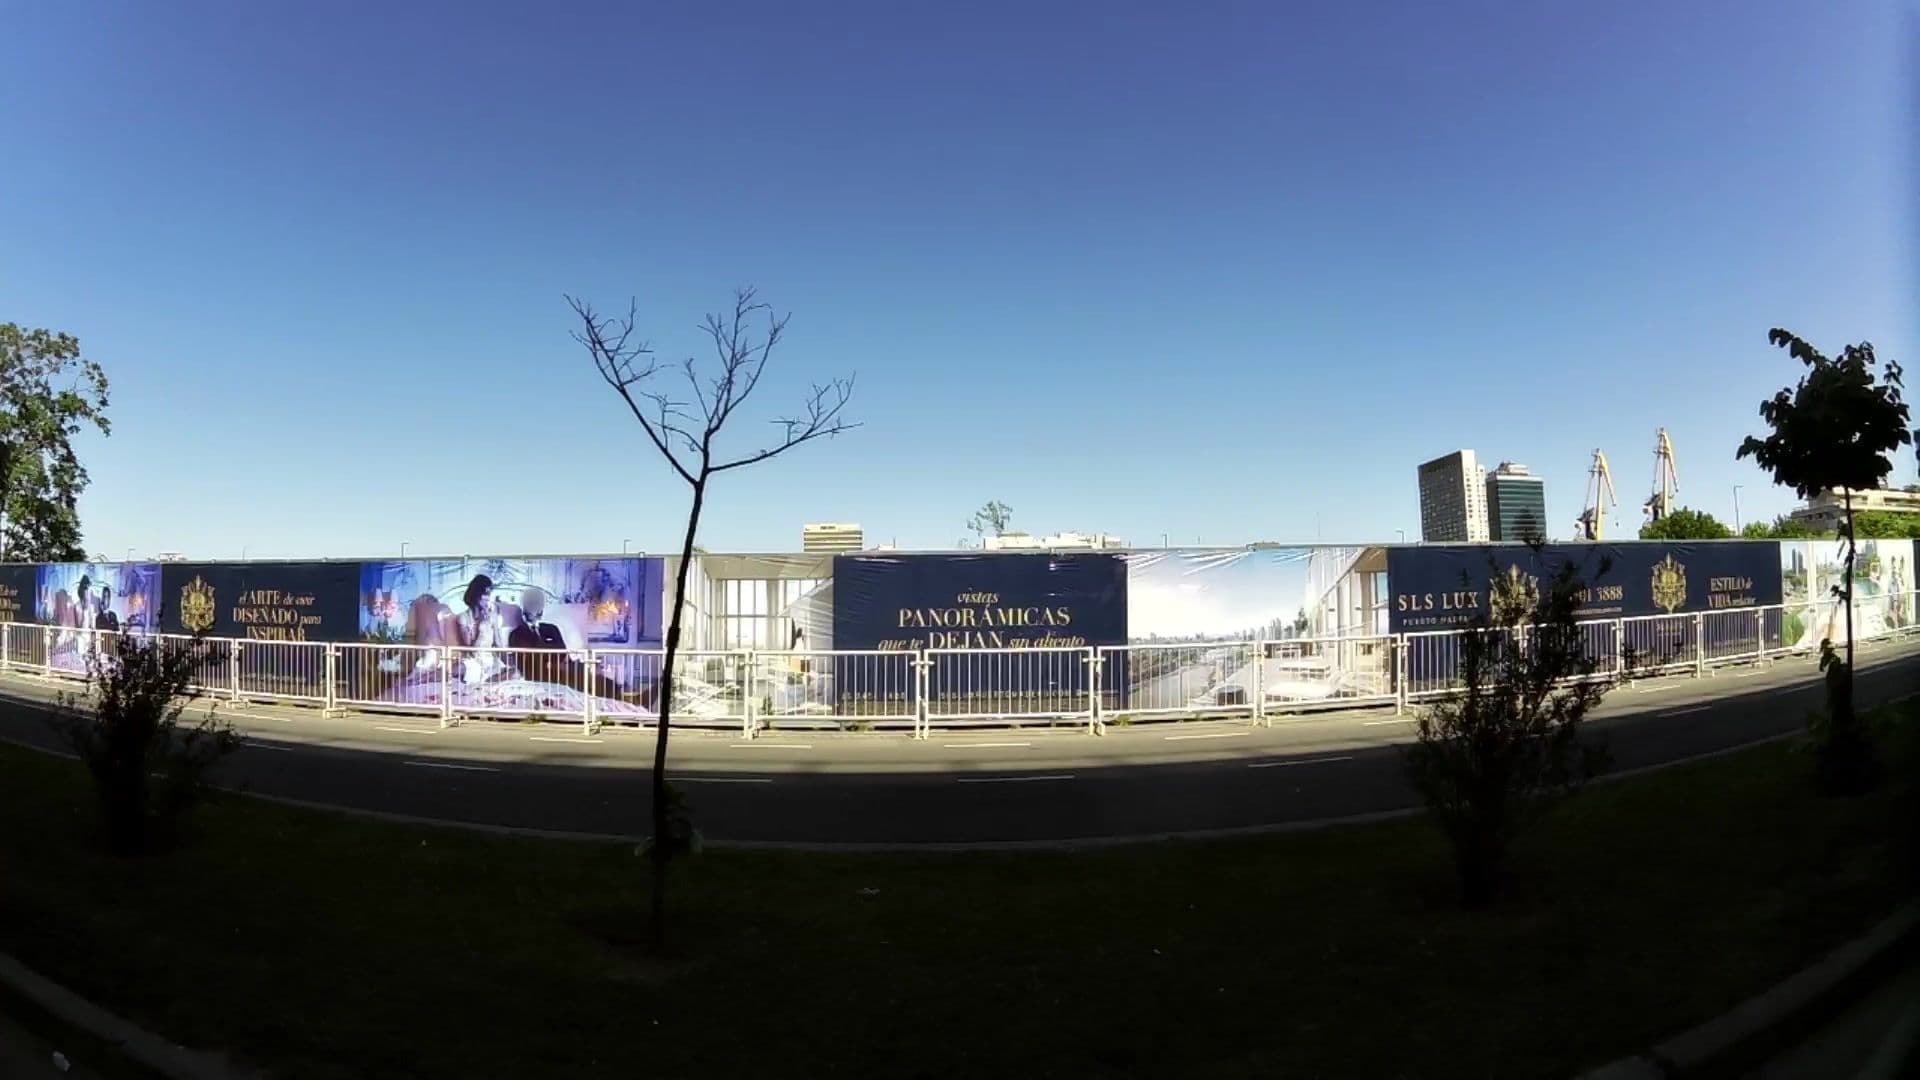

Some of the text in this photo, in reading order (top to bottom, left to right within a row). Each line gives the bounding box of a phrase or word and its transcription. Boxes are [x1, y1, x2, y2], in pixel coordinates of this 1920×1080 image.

[1710, 576, 1745, 591] ESTILO
[249, 589, 280, 605] ARTE
[283, 592, 294, 605] de
[957, 587, 999, 603] vistas
[1398, 591, 1479, 611] SLS LUX
[1595, 585, 1623, 601] 3888
[299, 615, 322, 626] para
[898, 604, 1071, 627] PANORÁMICAS
[878, 629, 1085, 651] que te DEJAN sin aliento
